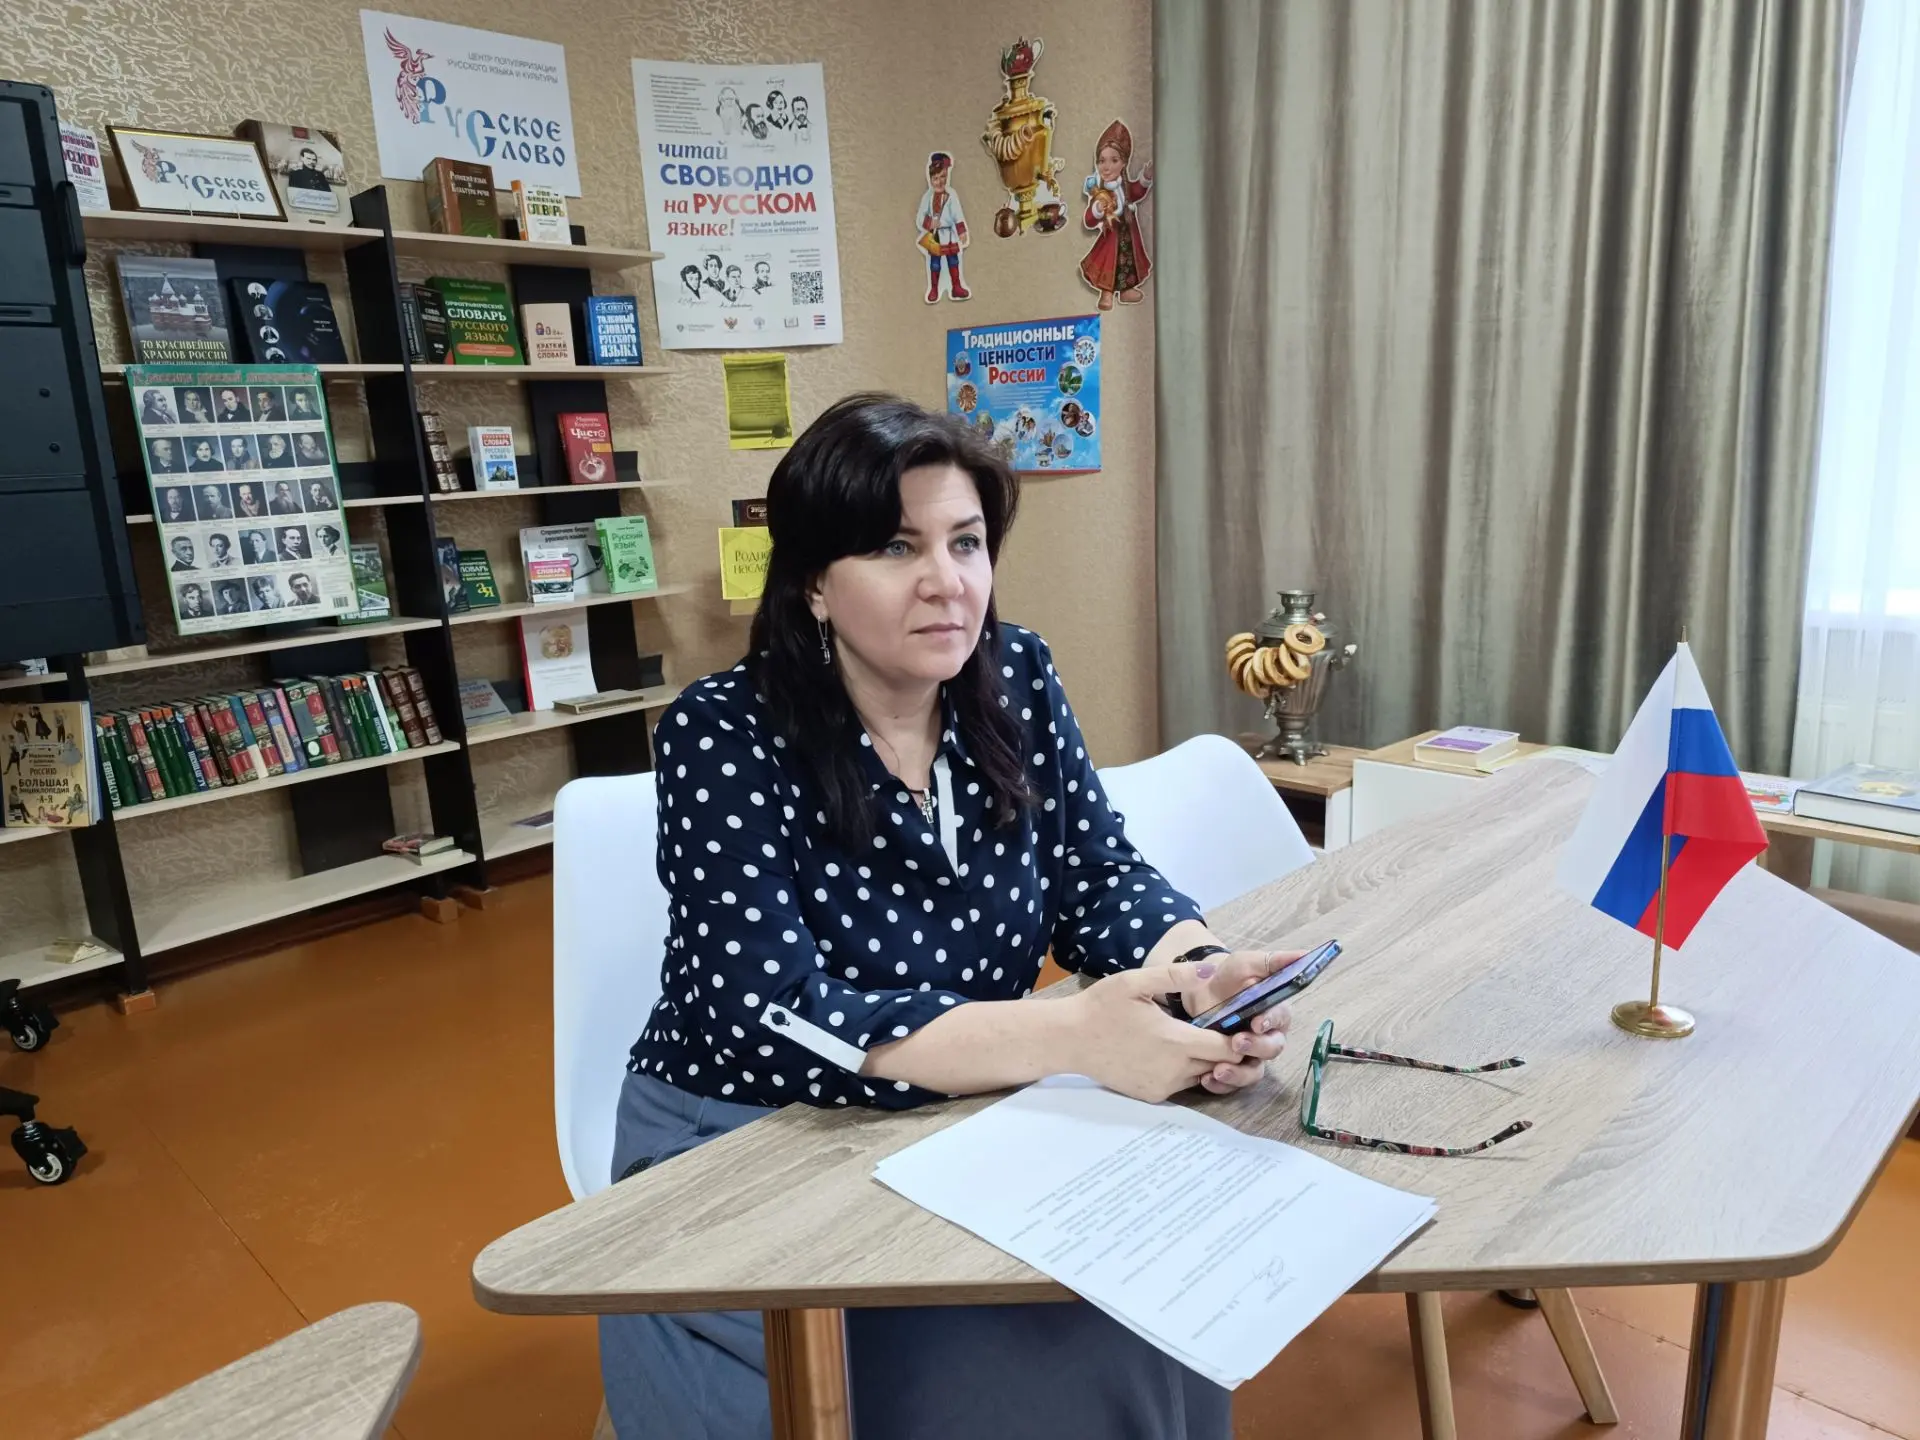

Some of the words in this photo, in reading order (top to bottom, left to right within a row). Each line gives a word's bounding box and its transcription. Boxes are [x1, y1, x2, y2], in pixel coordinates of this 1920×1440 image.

[468, 52, 493, 61] ЦЕНТР
[447, 58, 488, 73] РУССКОГО
[489, 66, 514, 76] ЯЗЫКА
[522, 71, 558, 83] КУЛЬТУРЫ
[657, 140, 728, 160] читай
[660, 163, 814, 191] СВОБОДНО
[664, 198, 688, 213] на
[693, 192, 817, 215] РУССКОМ
[527, 203, 565, 217] СЛОВАРЬ
[666, 218, 735, 237] языке!
[447, 308, 507, 321] СЛОВАРЬ
[597, 313, 635, 324] ТОЛКОВЫЙ
[450, 320, 509, 333] РУССКОГО
[598, 324, 636, 334] СЛОВАРЬ
[464, 332, 505, 343] ЯЗЫКА
[599, 334, 637, 345] РУССКОГО
[962, 325, 1075, 350] ТРАДИЦИОННЫЕ
[141, 339, 153, 349] 70
[155, 339, 226, 350] КРАСИВЕЙШИХ
[536, 342, 568, 350] КРАТКИЙ
[143, 350, 186, 360] ХРАМОВ
[188, 350, 228, 360] РОССИИ
[537, 351, 568, 359] СЛОВАРЬ
[600, 344, 639, 358] ЯЗЫКА
[978, 346, 1055, 367] ЦЕННОСТИ
[988, 366, 1045, 385] РОССИИ
[570, 428, 606, 438] Чисто
[612, 530, 643, 542] Русский
[19, 778, 68, 788] БОЛЬШАЯ
